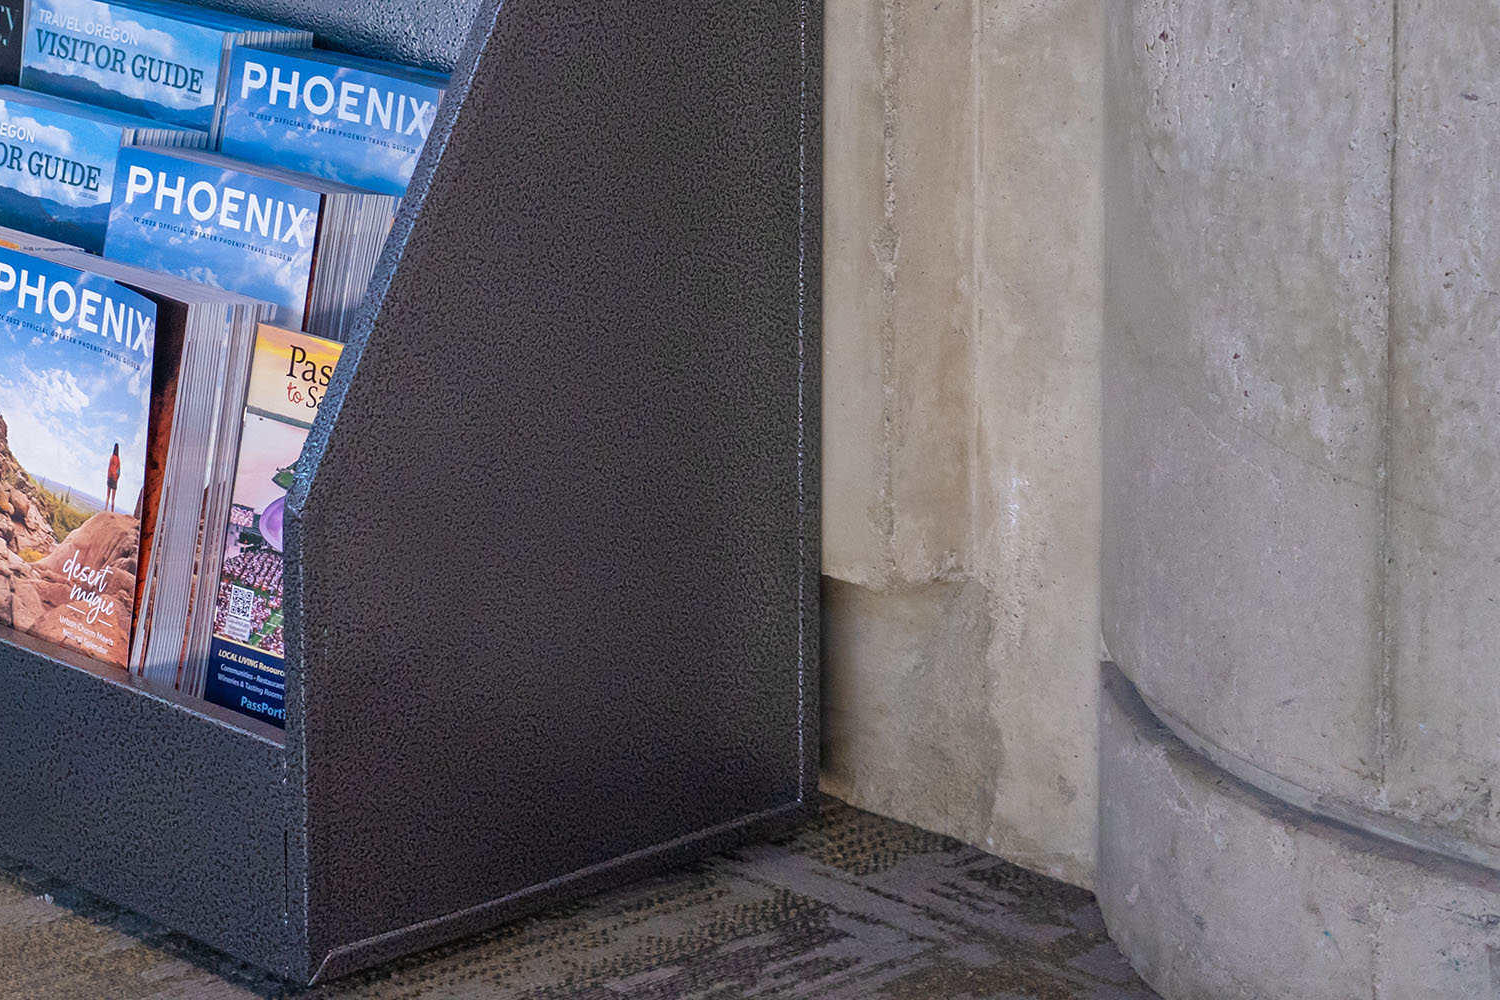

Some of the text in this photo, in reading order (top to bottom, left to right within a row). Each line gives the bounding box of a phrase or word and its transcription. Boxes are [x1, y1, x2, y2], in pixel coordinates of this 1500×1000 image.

[39, 8, 140, 46] TRAVEL OREGON
[36, 28, 204, 94] VISITOR GUIDE
[240, 60, 432, 140] PHOENIX
[274, 115, 305, 131] OFFICIAL
[306, 122, 337, 137] GREATER
[338, 129, 367, 143] PHOENIX
[368, 136, 392, 148] TRAVEL
[392, 141, 412, 154] GUIDE
[63, 550, 114, 592] desert
[69, 584, 114, 624] magic
[218, 648, 238, 662] LOCAL
[238, 655, 258, 669] LIVING
